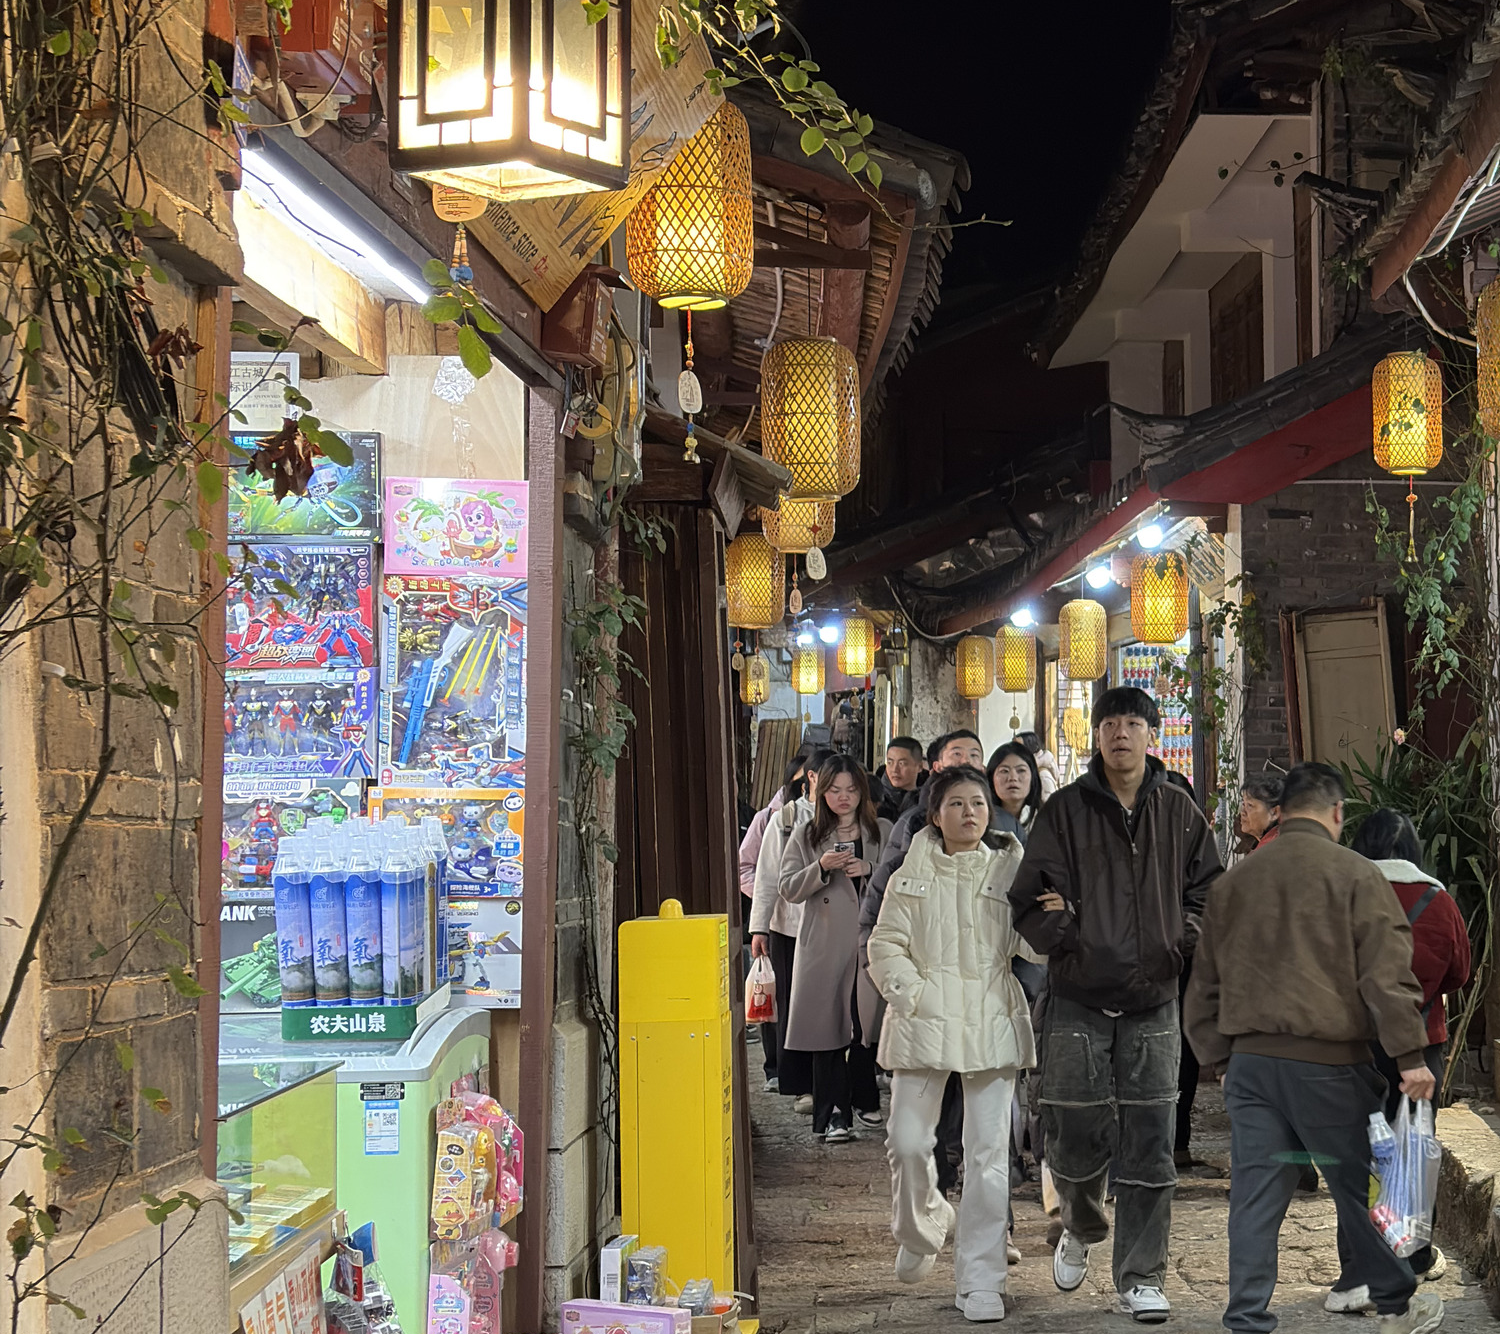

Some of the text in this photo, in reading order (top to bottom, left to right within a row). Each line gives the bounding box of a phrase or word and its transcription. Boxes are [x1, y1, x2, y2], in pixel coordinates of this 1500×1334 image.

[512, 232, 539, 264] store
[219, 905, 257, 921] ANK
[280, 938, 302, 968] 氧
[316, 937, 339, 968] 氧
[352, 936, 375, 967] 氧
[309, 1012, 387, 1035] 农夫山泉
